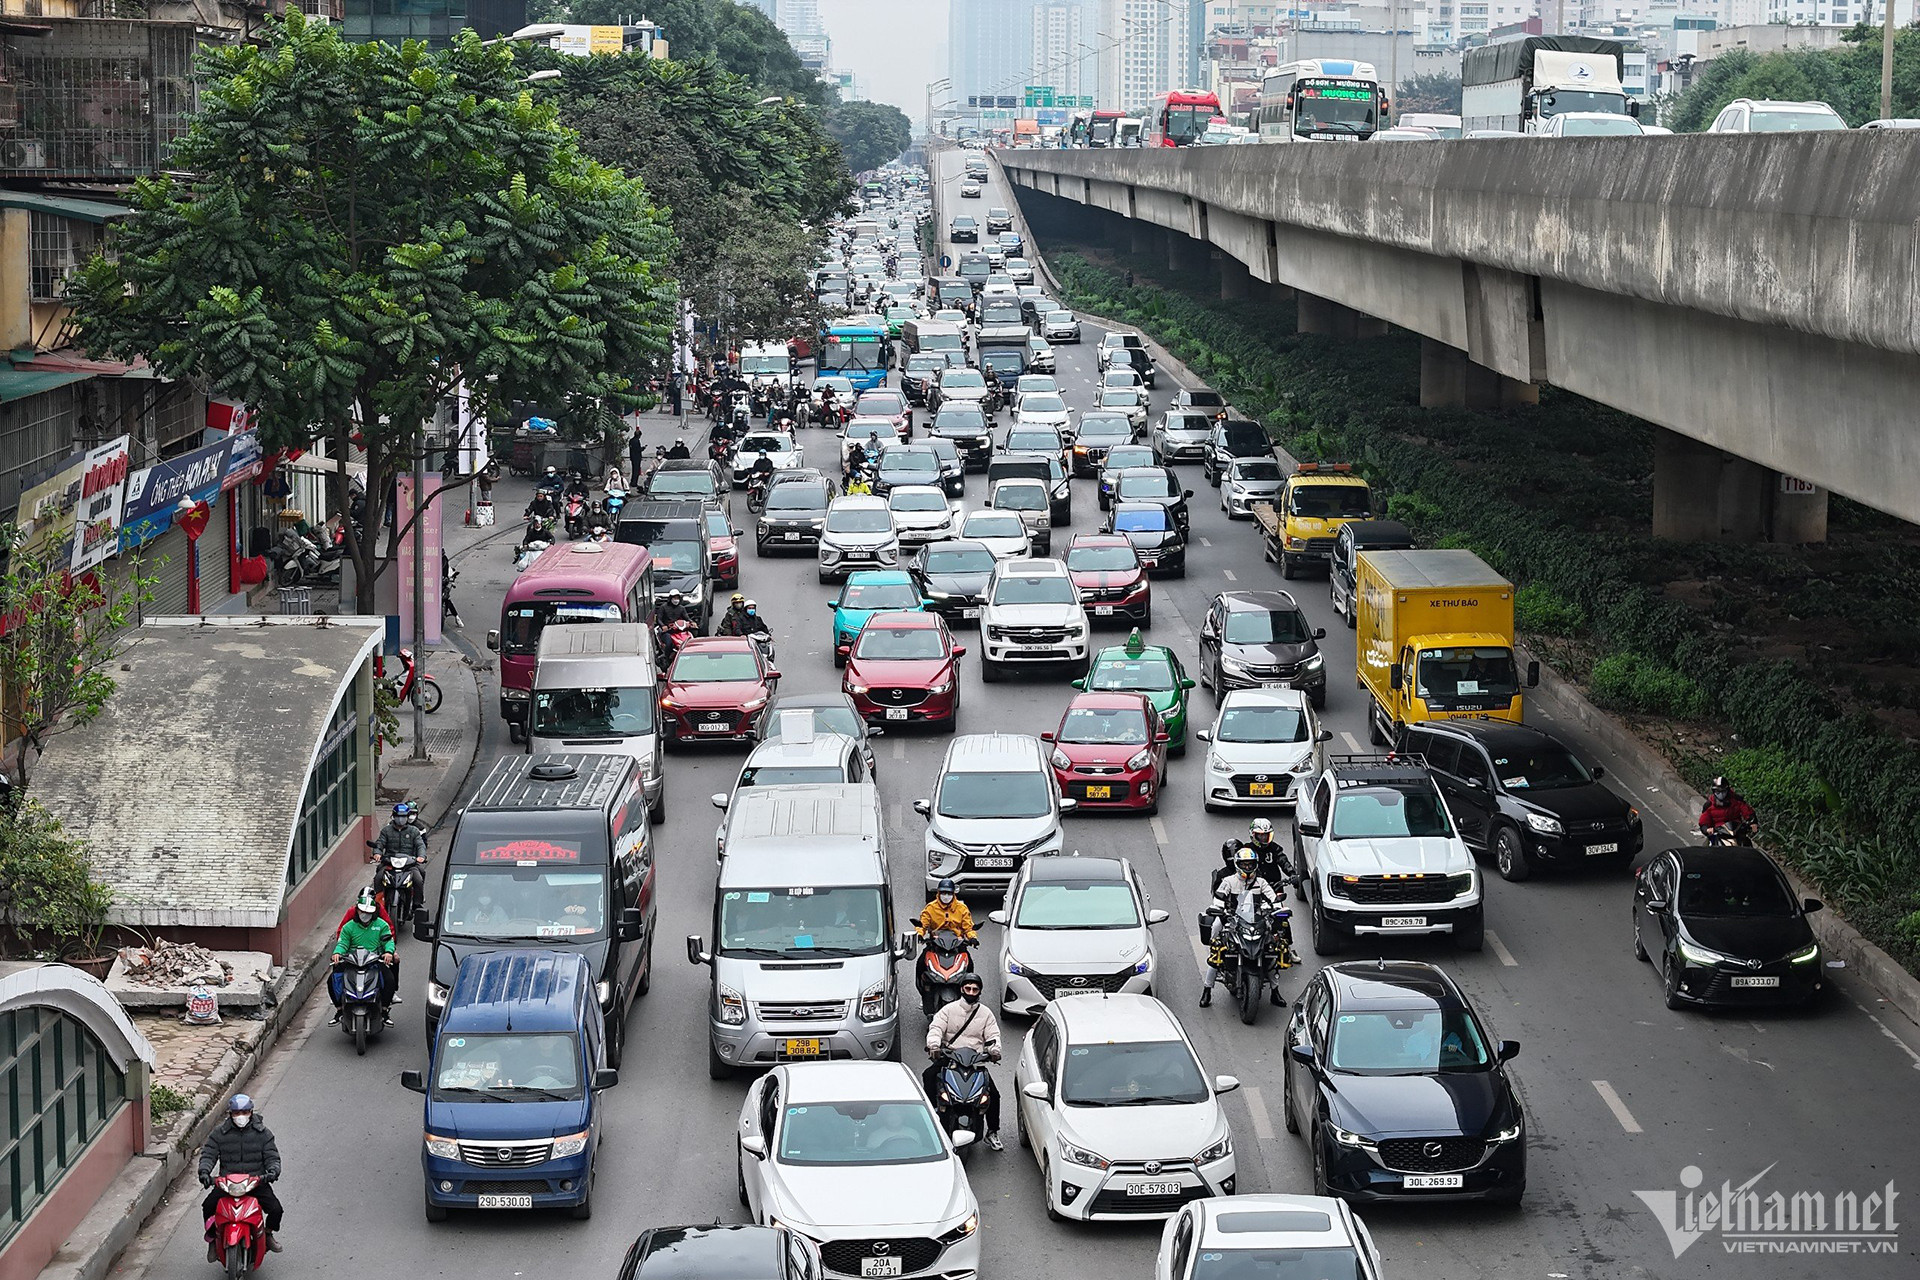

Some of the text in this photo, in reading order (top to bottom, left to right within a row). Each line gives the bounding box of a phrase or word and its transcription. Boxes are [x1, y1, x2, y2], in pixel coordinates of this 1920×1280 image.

[1442, 599, 1460, 607] THƯ
[1461, 598, 1478, 607] BÁO
[480, 849, 577, 860] LIMOUSINE
[873, 1259, 890, 1267] 20A
[865, 1267, 899, 1276] 607.31
